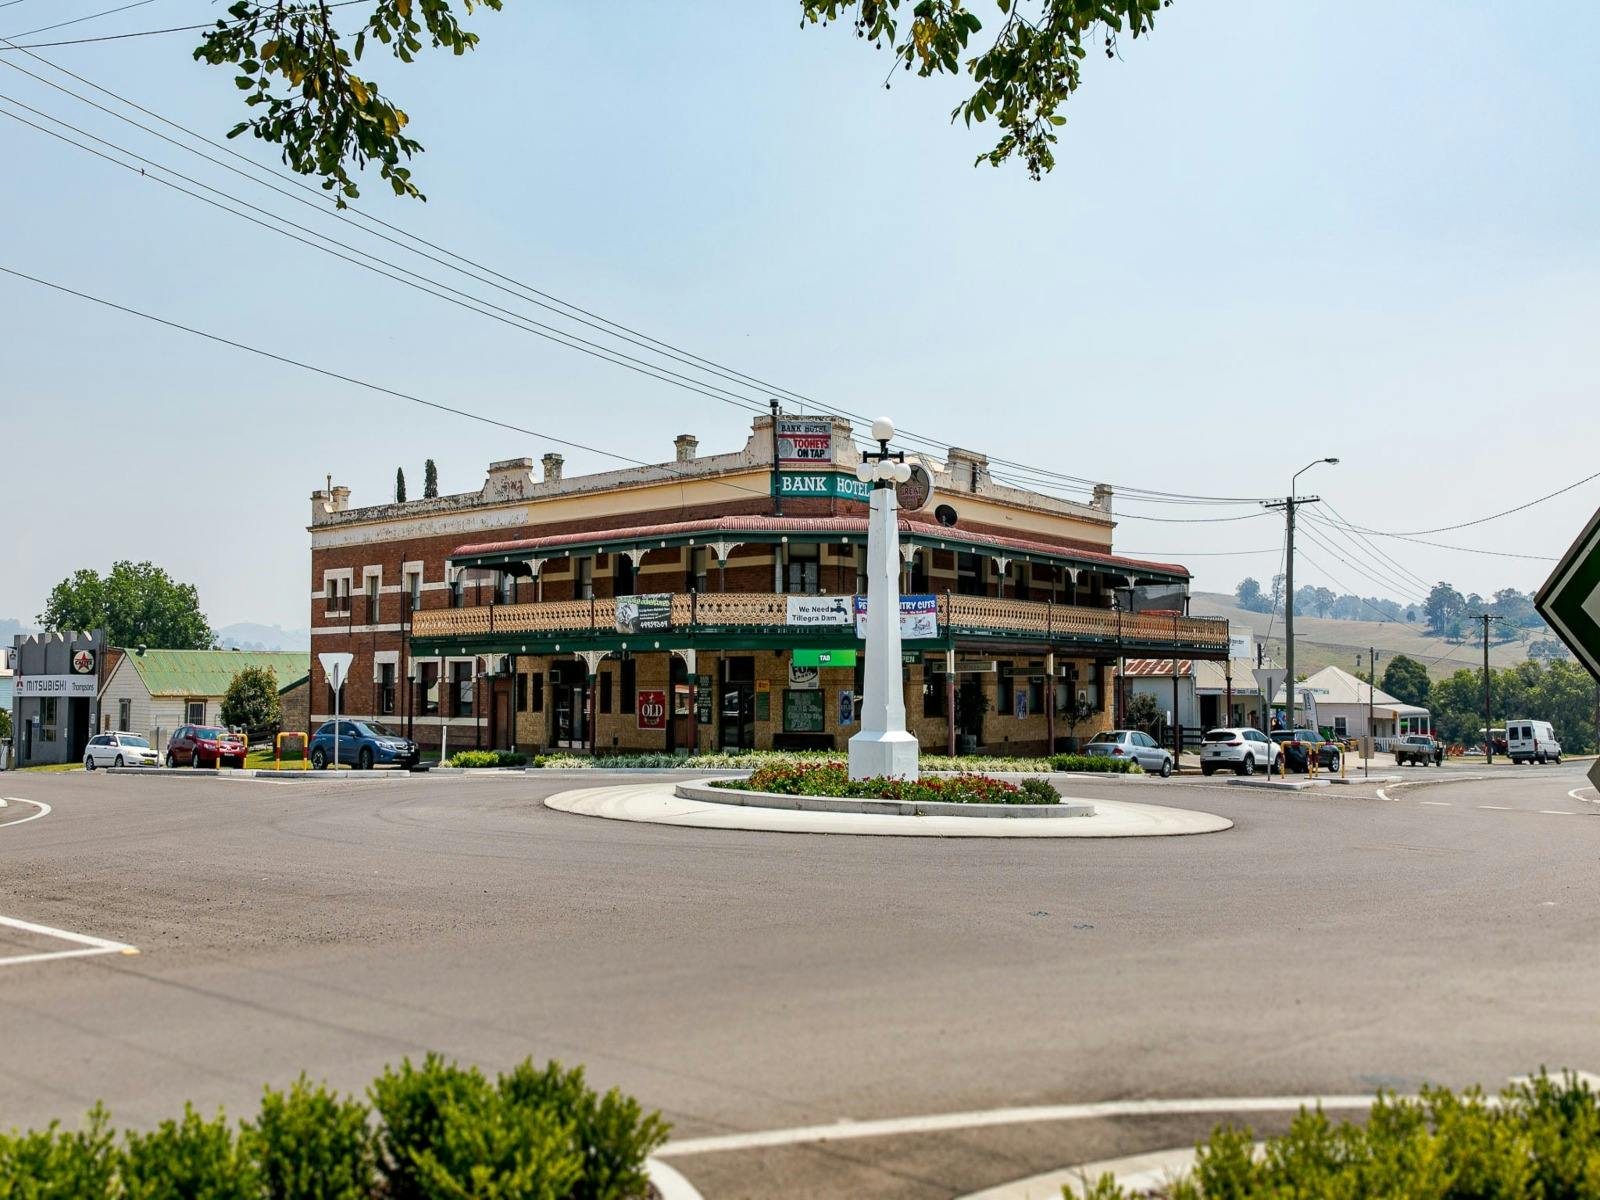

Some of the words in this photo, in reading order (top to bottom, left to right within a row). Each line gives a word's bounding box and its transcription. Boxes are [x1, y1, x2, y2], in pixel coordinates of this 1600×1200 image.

[781, 424, 801, 432] BANK
[805, 425, 828, 433] HOTEL
[794, 439, 829, 448] TOOHEYS
[797, 449, 809, 458] ON
[811, 449, 825, 458] TAP
[782, 476, 827, 491] BANK
[837, 477, 870, 497] HOTEL
[917, 600, 936, 609] CUTS
[792, 615, 819, 623] Tillegra
[902, 655, 915, 663] PEN
[26, 679, 67, 691] MITSUBISHI
[642, 704, 663, 717] OLD
